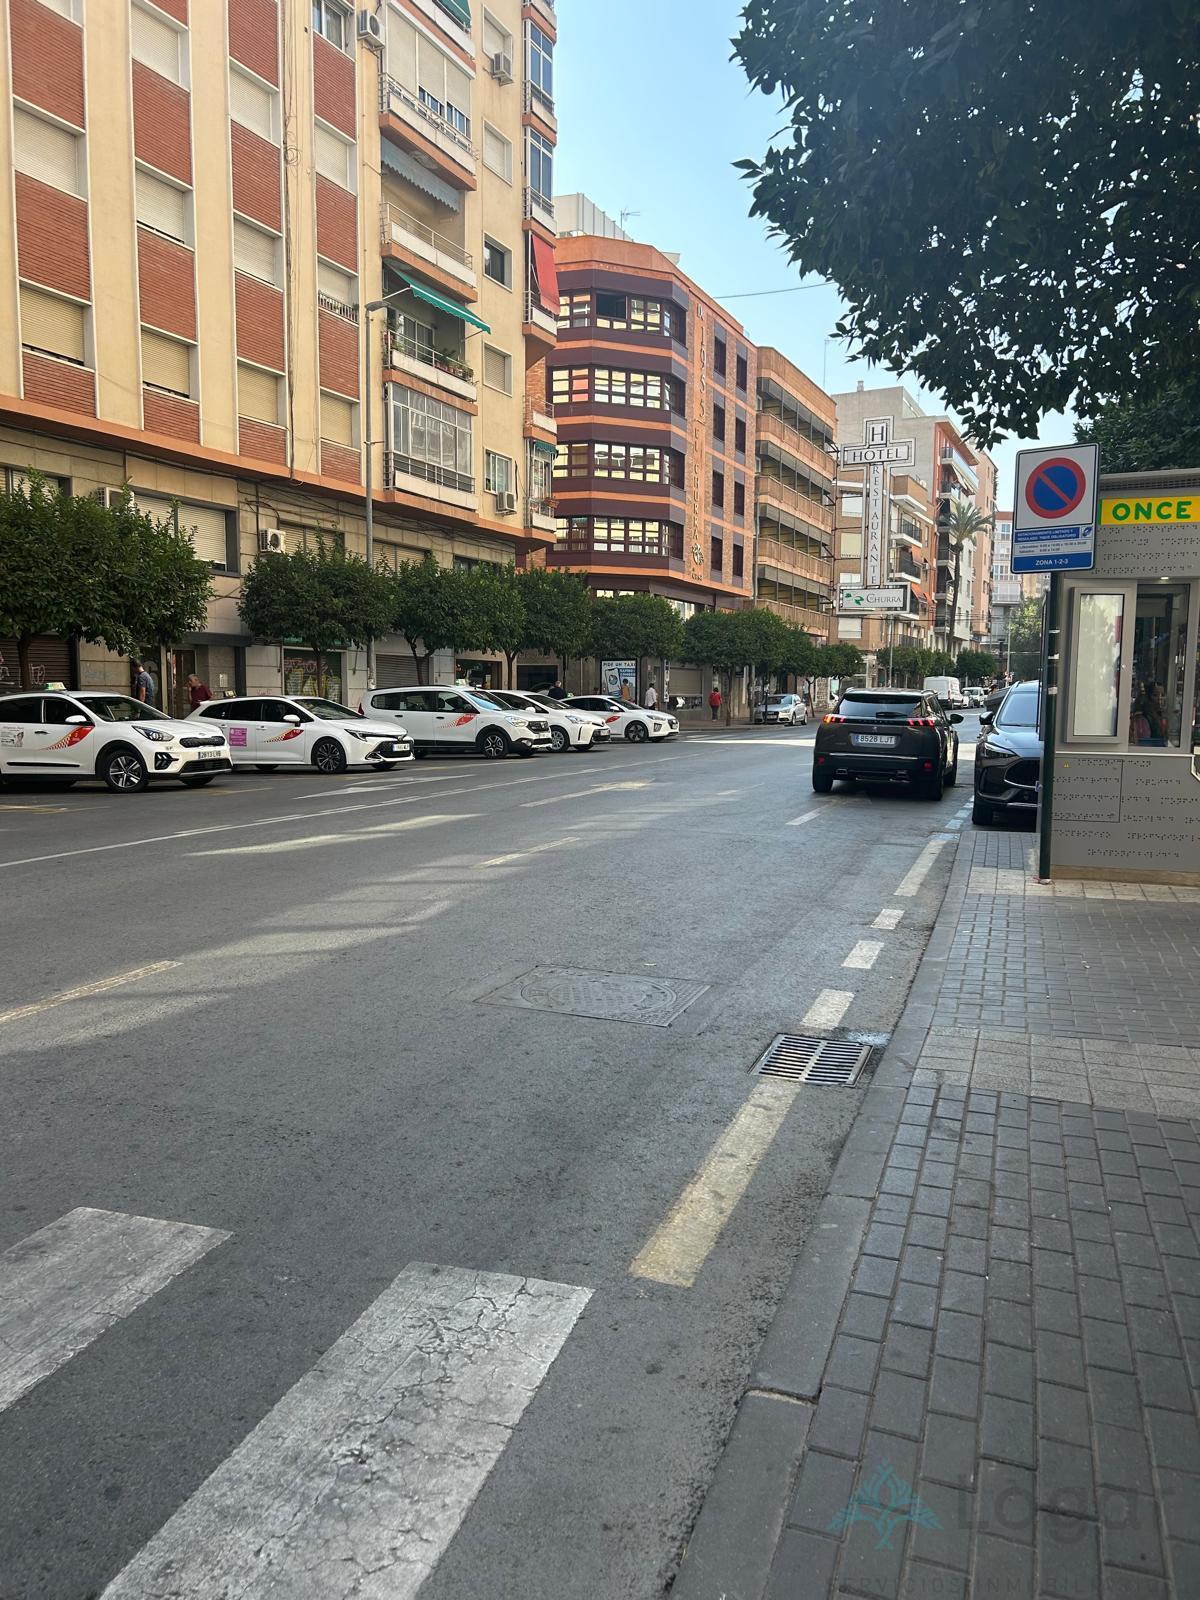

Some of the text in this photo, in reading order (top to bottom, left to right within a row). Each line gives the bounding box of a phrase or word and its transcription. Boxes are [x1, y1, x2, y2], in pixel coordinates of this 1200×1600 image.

[872, 425, 884, 442] H
[853, 447, 903, 462] HOTEL
[1112, 501, 1193, 521] ONCE
[871, 464, 880, 585] RESTAURANTE
